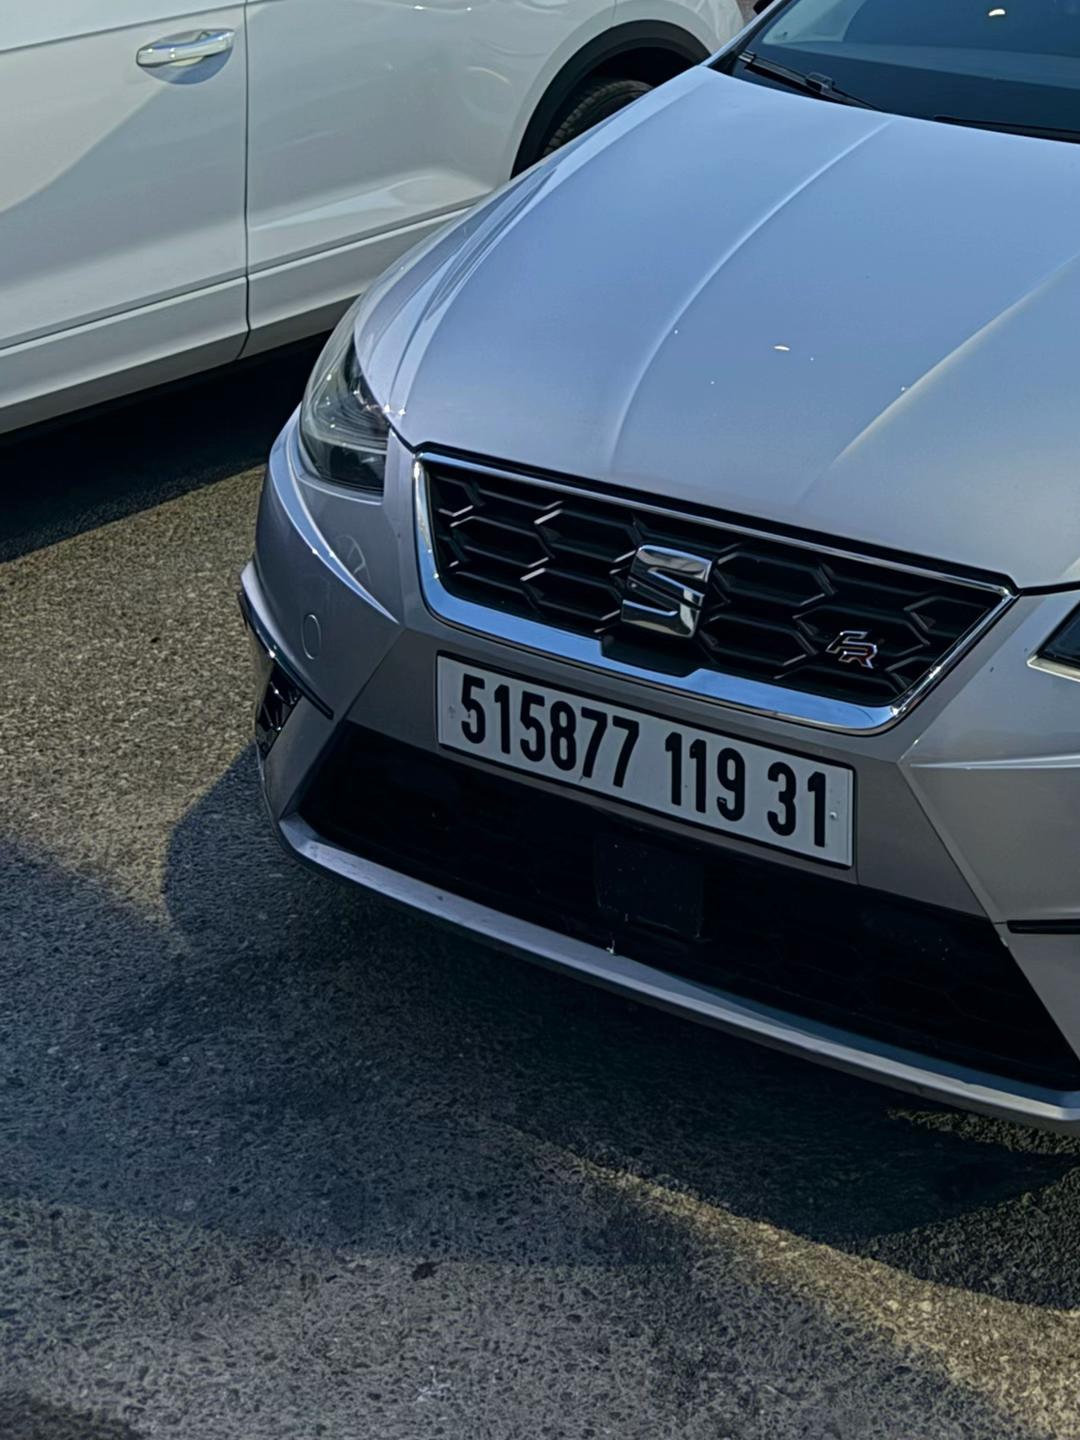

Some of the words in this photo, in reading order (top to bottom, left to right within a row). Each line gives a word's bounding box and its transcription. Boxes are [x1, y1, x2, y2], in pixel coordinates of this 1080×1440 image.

[825, 630, 878, 669] FR
[460, 672, 640, 789] 515877
[664, 730, 747, 823] 119
[766, 761, 827, 849] 31
